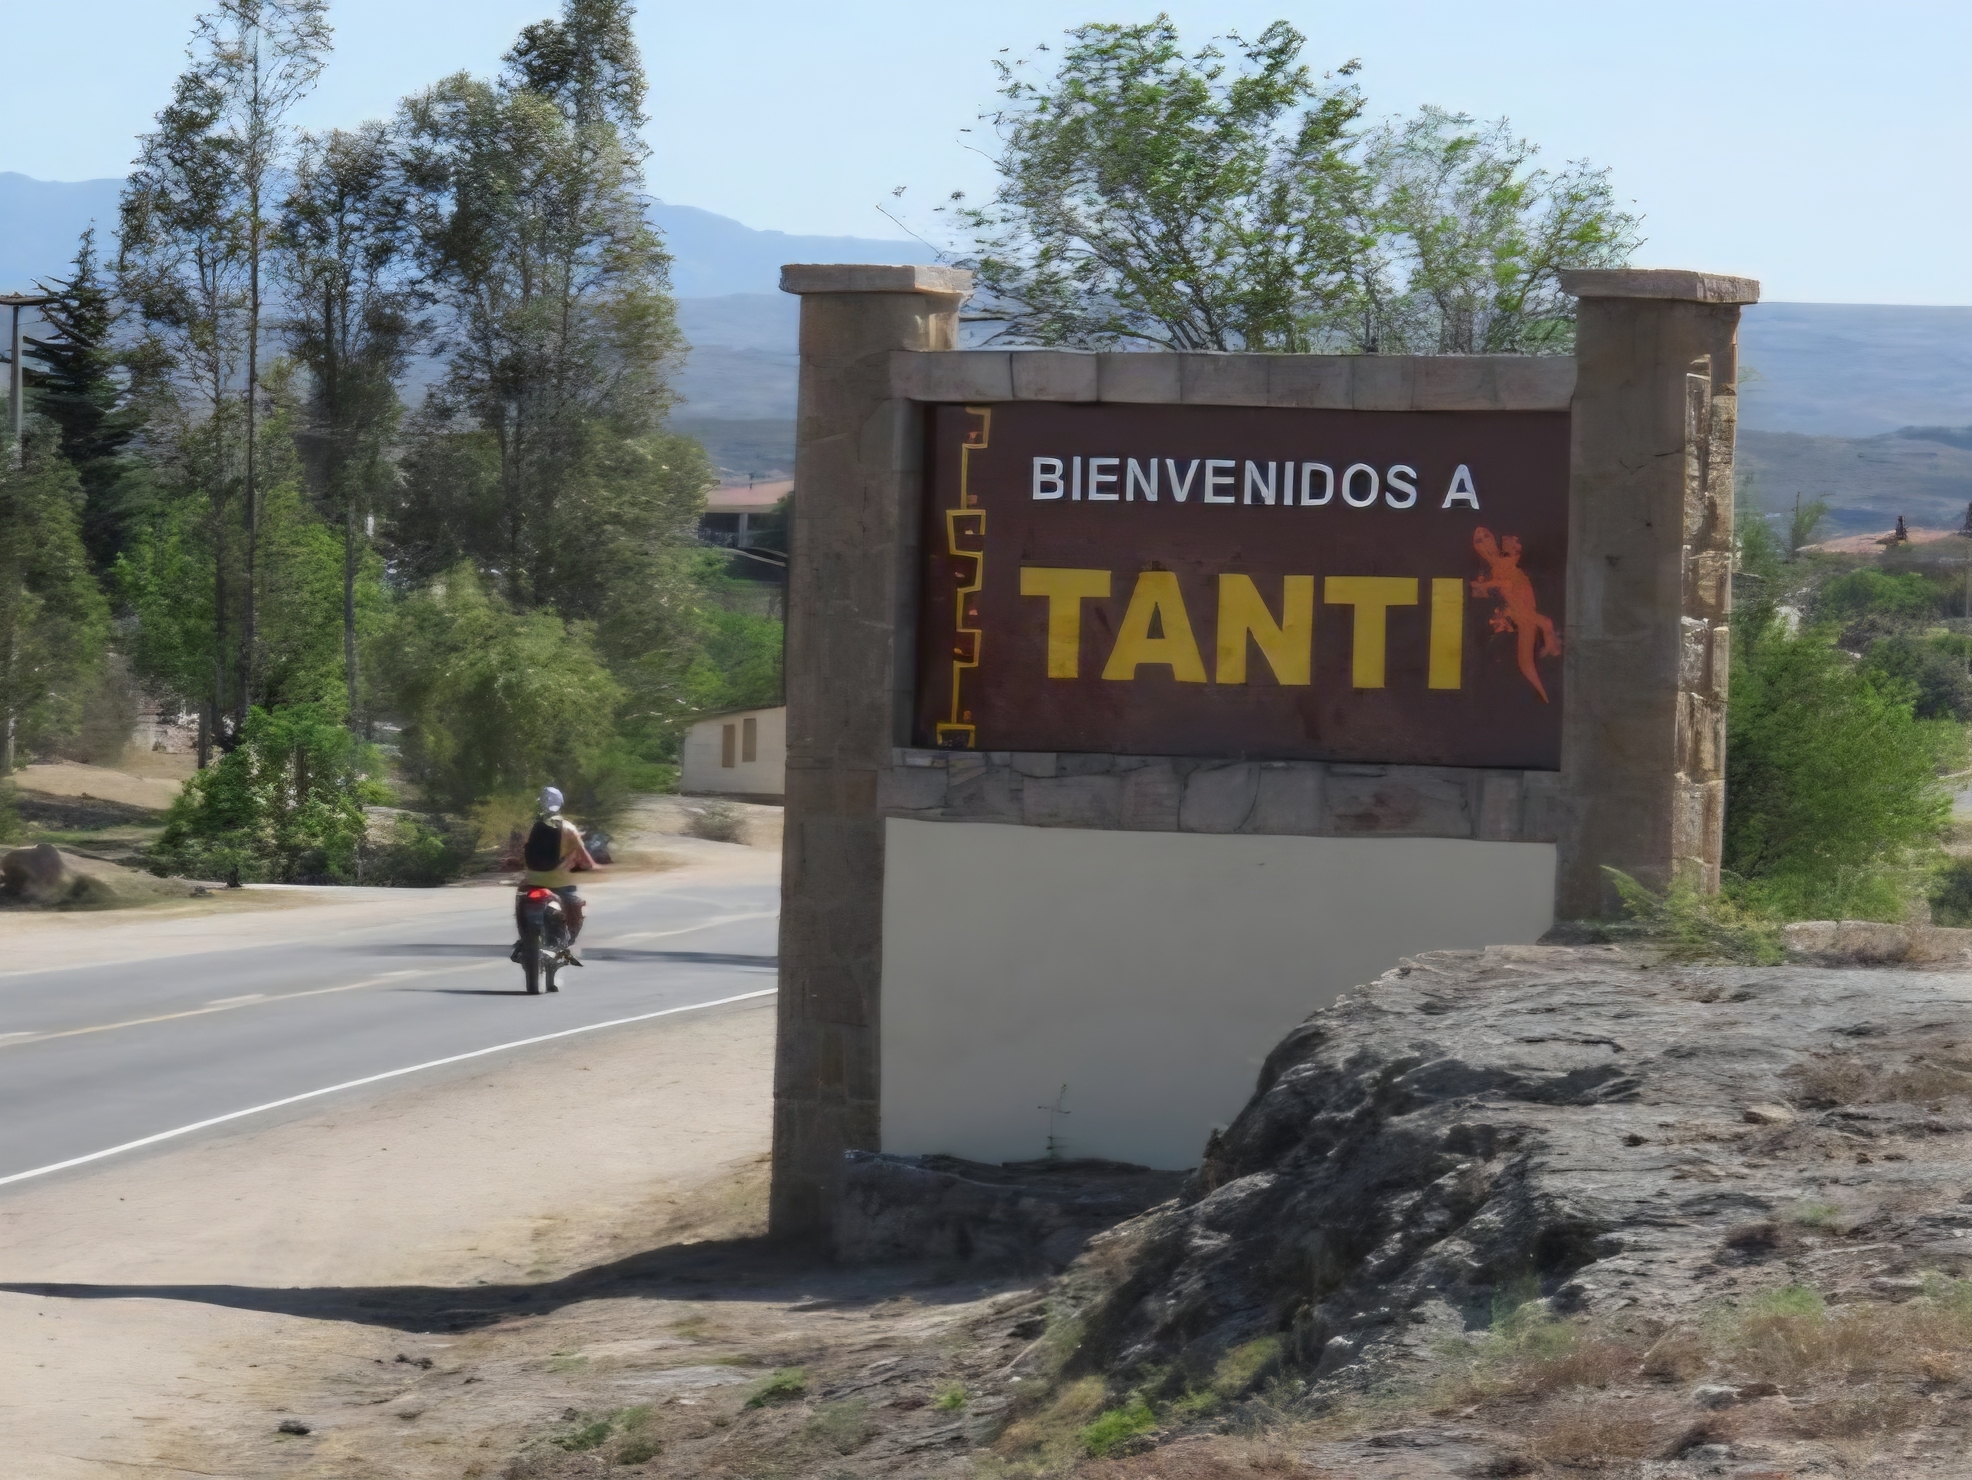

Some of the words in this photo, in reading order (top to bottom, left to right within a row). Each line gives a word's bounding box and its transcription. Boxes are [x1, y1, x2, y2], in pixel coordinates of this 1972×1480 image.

[1031, 456, 1419, 509] BIENVENIDOS
[1441, 463, 1480, 510] A
[1019, 566, 1464, 690] TANTI
